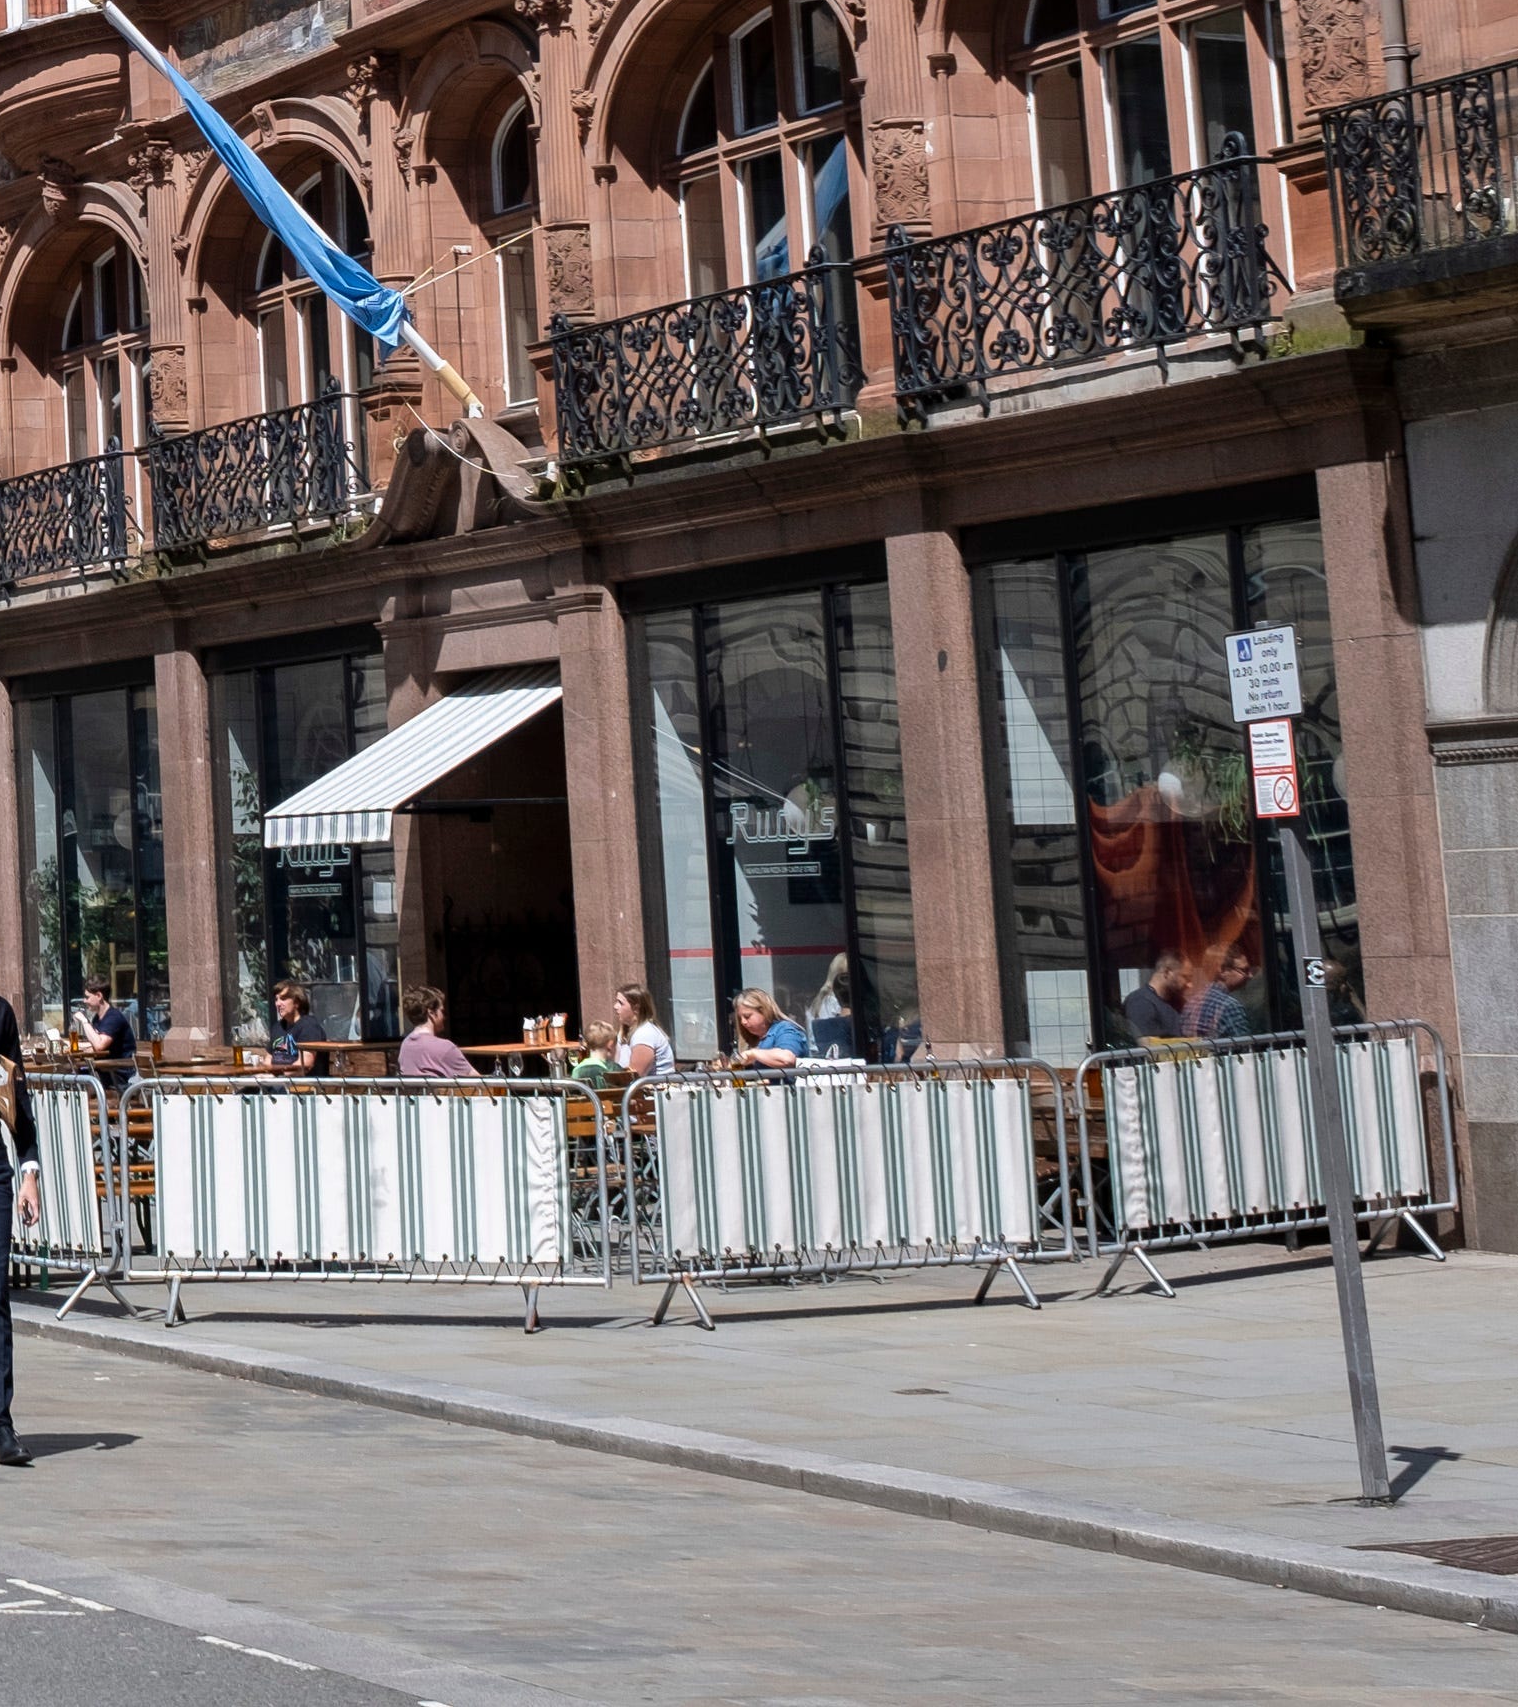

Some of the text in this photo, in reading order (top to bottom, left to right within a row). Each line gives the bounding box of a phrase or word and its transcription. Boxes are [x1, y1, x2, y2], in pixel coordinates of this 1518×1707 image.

[1253, 633, 1284, 645] Loading
[1261, 647, 1277, 657] only
[1249, 677, 1280, 688] 30 mins
[1247, 690, 1283, 701] No return
[1244, 704, 1265, 714] within
[1273, 702, 1290, 710] hour
